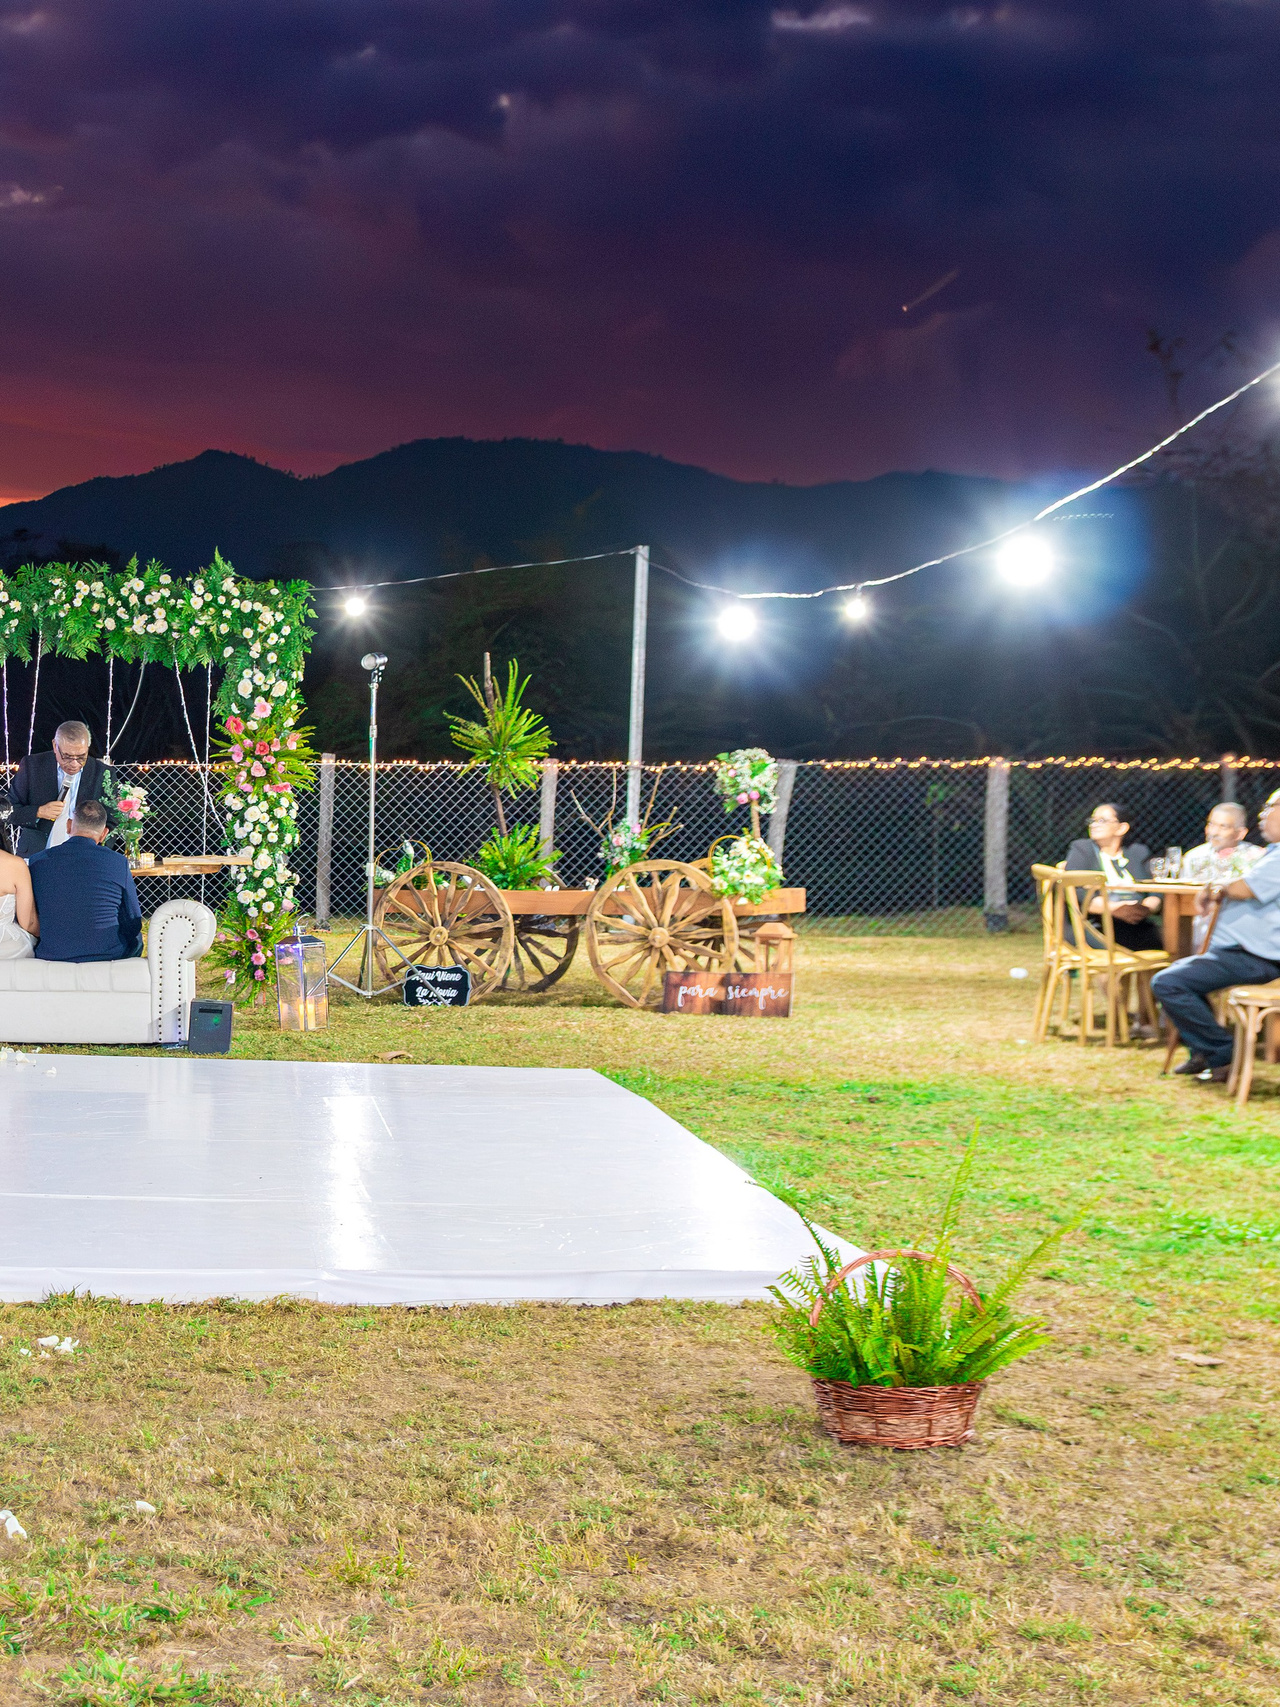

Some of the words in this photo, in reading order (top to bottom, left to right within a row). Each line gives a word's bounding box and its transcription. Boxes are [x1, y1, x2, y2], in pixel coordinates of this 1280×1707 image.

[435, 971, 462, 982] Viene
[415, 986, 429, 998] La
[677, 985, 718, 1008] para
[727, 985, 789, 1010] siempre
